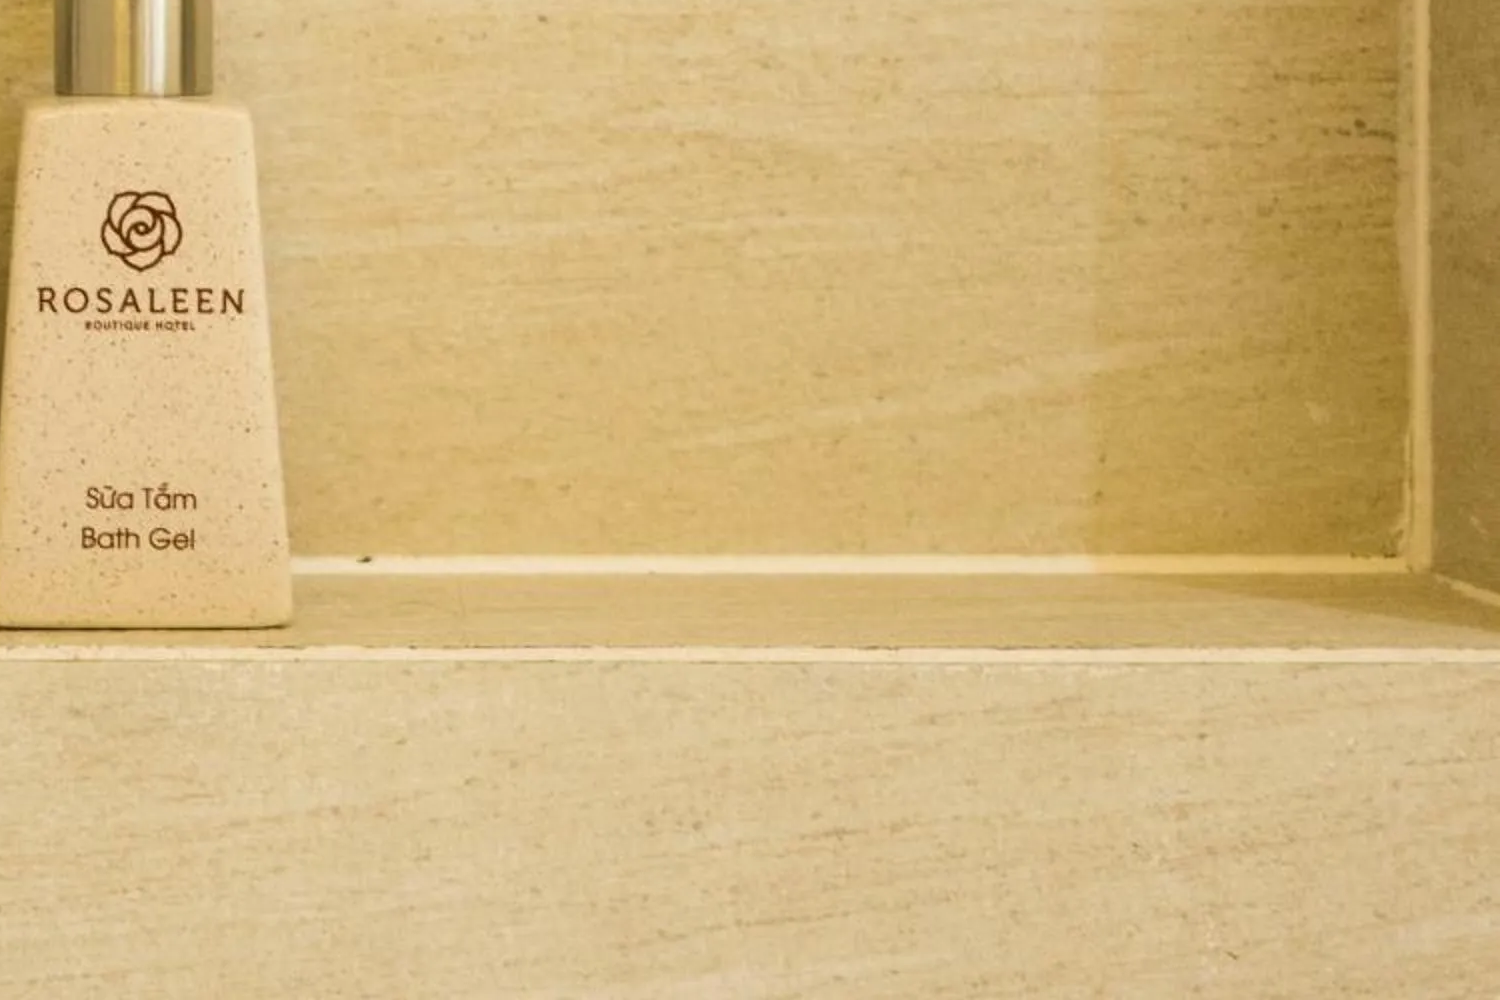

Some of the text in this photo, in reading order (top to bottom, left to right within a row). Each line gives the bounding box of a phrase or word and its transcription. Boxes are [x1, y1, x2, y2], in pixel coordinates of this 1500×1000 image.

[37, 286, 245, 314] ROSALEEN
[84, 319, 196, 331] BOUTIQUE HOTEL
[85, 484, 134, 511] Sữa
[81, 526, 196, 551] Bath Gel
